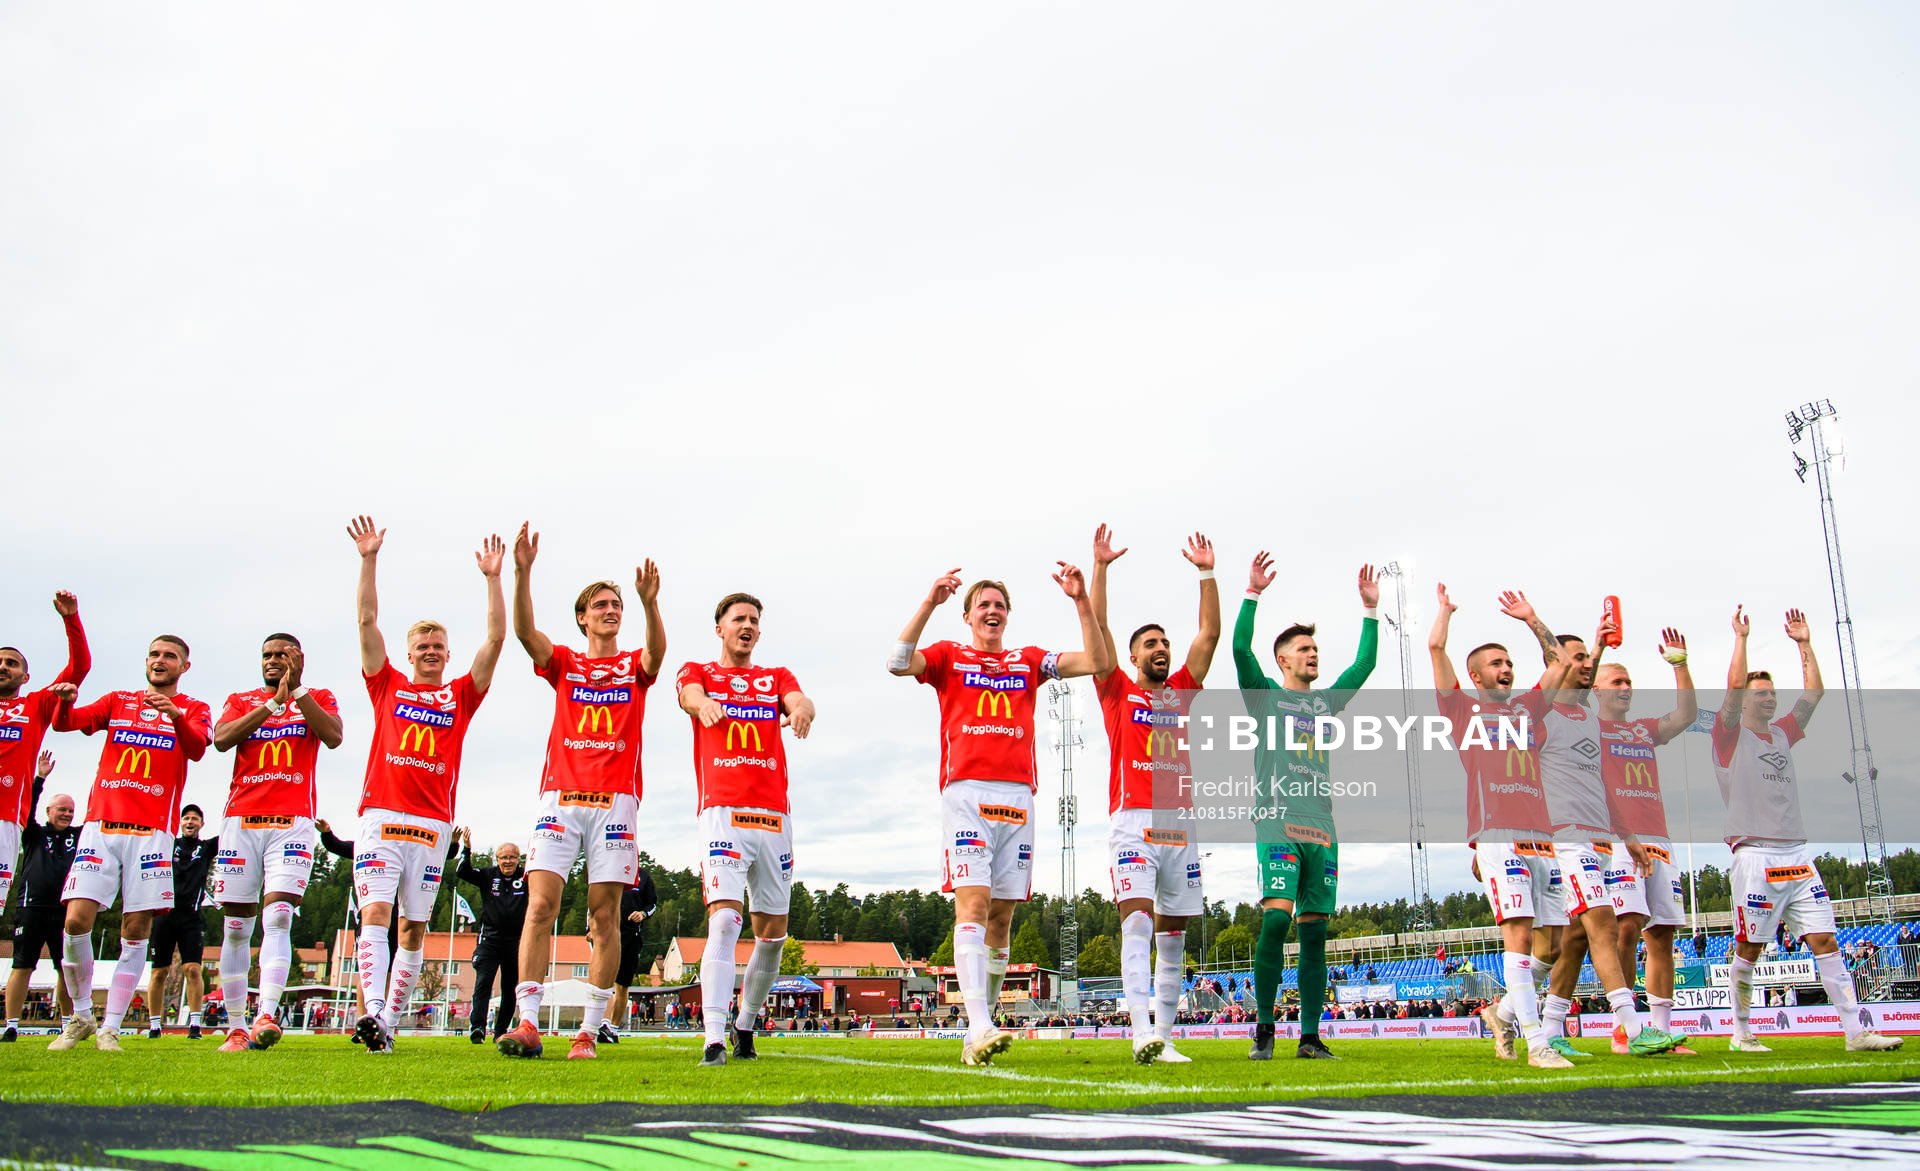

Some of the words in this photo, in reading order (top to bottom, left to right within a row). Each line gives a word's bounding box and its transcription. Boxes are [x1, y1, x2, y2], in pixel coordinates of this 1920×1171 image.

[965, 673, 1024, 689] Helmia
[572, 688, 628, 702] Helmia
[396, 704, 454, 726] Helmia
[1134, 710, 1178, 724] Helmi
[962, 724, 1014, 736] ByggDialog
[114, 730, 173, 749] Helmia
[564, 738, 616, 750] ByggDialog
[386, 753, 436, 772] ByggDialog
[714, 756, 766, 768] ByggDialog
[1132, 760, 1178, 772] ByggDialog
[242, 771, 292, 784] ByggDialog
[100, 779, 150, 793] ByggDialog
[1490, 782, 1538, 797] ByggDialog
[563, 794, 610, 803] UNIFLEX
[735, 815, 778, 827] UNIFLEX
[385, 827, 434, 842] UNIFLEX
[140, 852, 163, 861] CEOS
[356, 853, 377, 862] CEOS
[530, 848, 536, 861] 2
[780, 852, 792, 862] CEO
[283, 858, 310, 868] D-LAB
[710, 859, 740, 868] D-LAB
[1187, 862, 1200, 871] CEO
[142, 870, 172, 880] D-LAB
[425, 866, 441, 874] CEOS
[957, 864, 969, 878] 21
[712, 875, 720, 888] 4
[1120, 878, 1132, 891] 15
[1271, 876, 1286, 890] 25
[358, 884, 369, 898] 18
[1592, 886, 1602, 898] 19
[1510, 894, 1522, 908] 17
[1612, 896, 1624, 908] 16
[1750, 923, 1756, 935] 9
[1715, 968, 1729, 978] KM
[1754, 966, 1775, 977] MAB
[1780, 964, 1810, 975] KMAB
[1406, 984, 1435, 996] bravida
